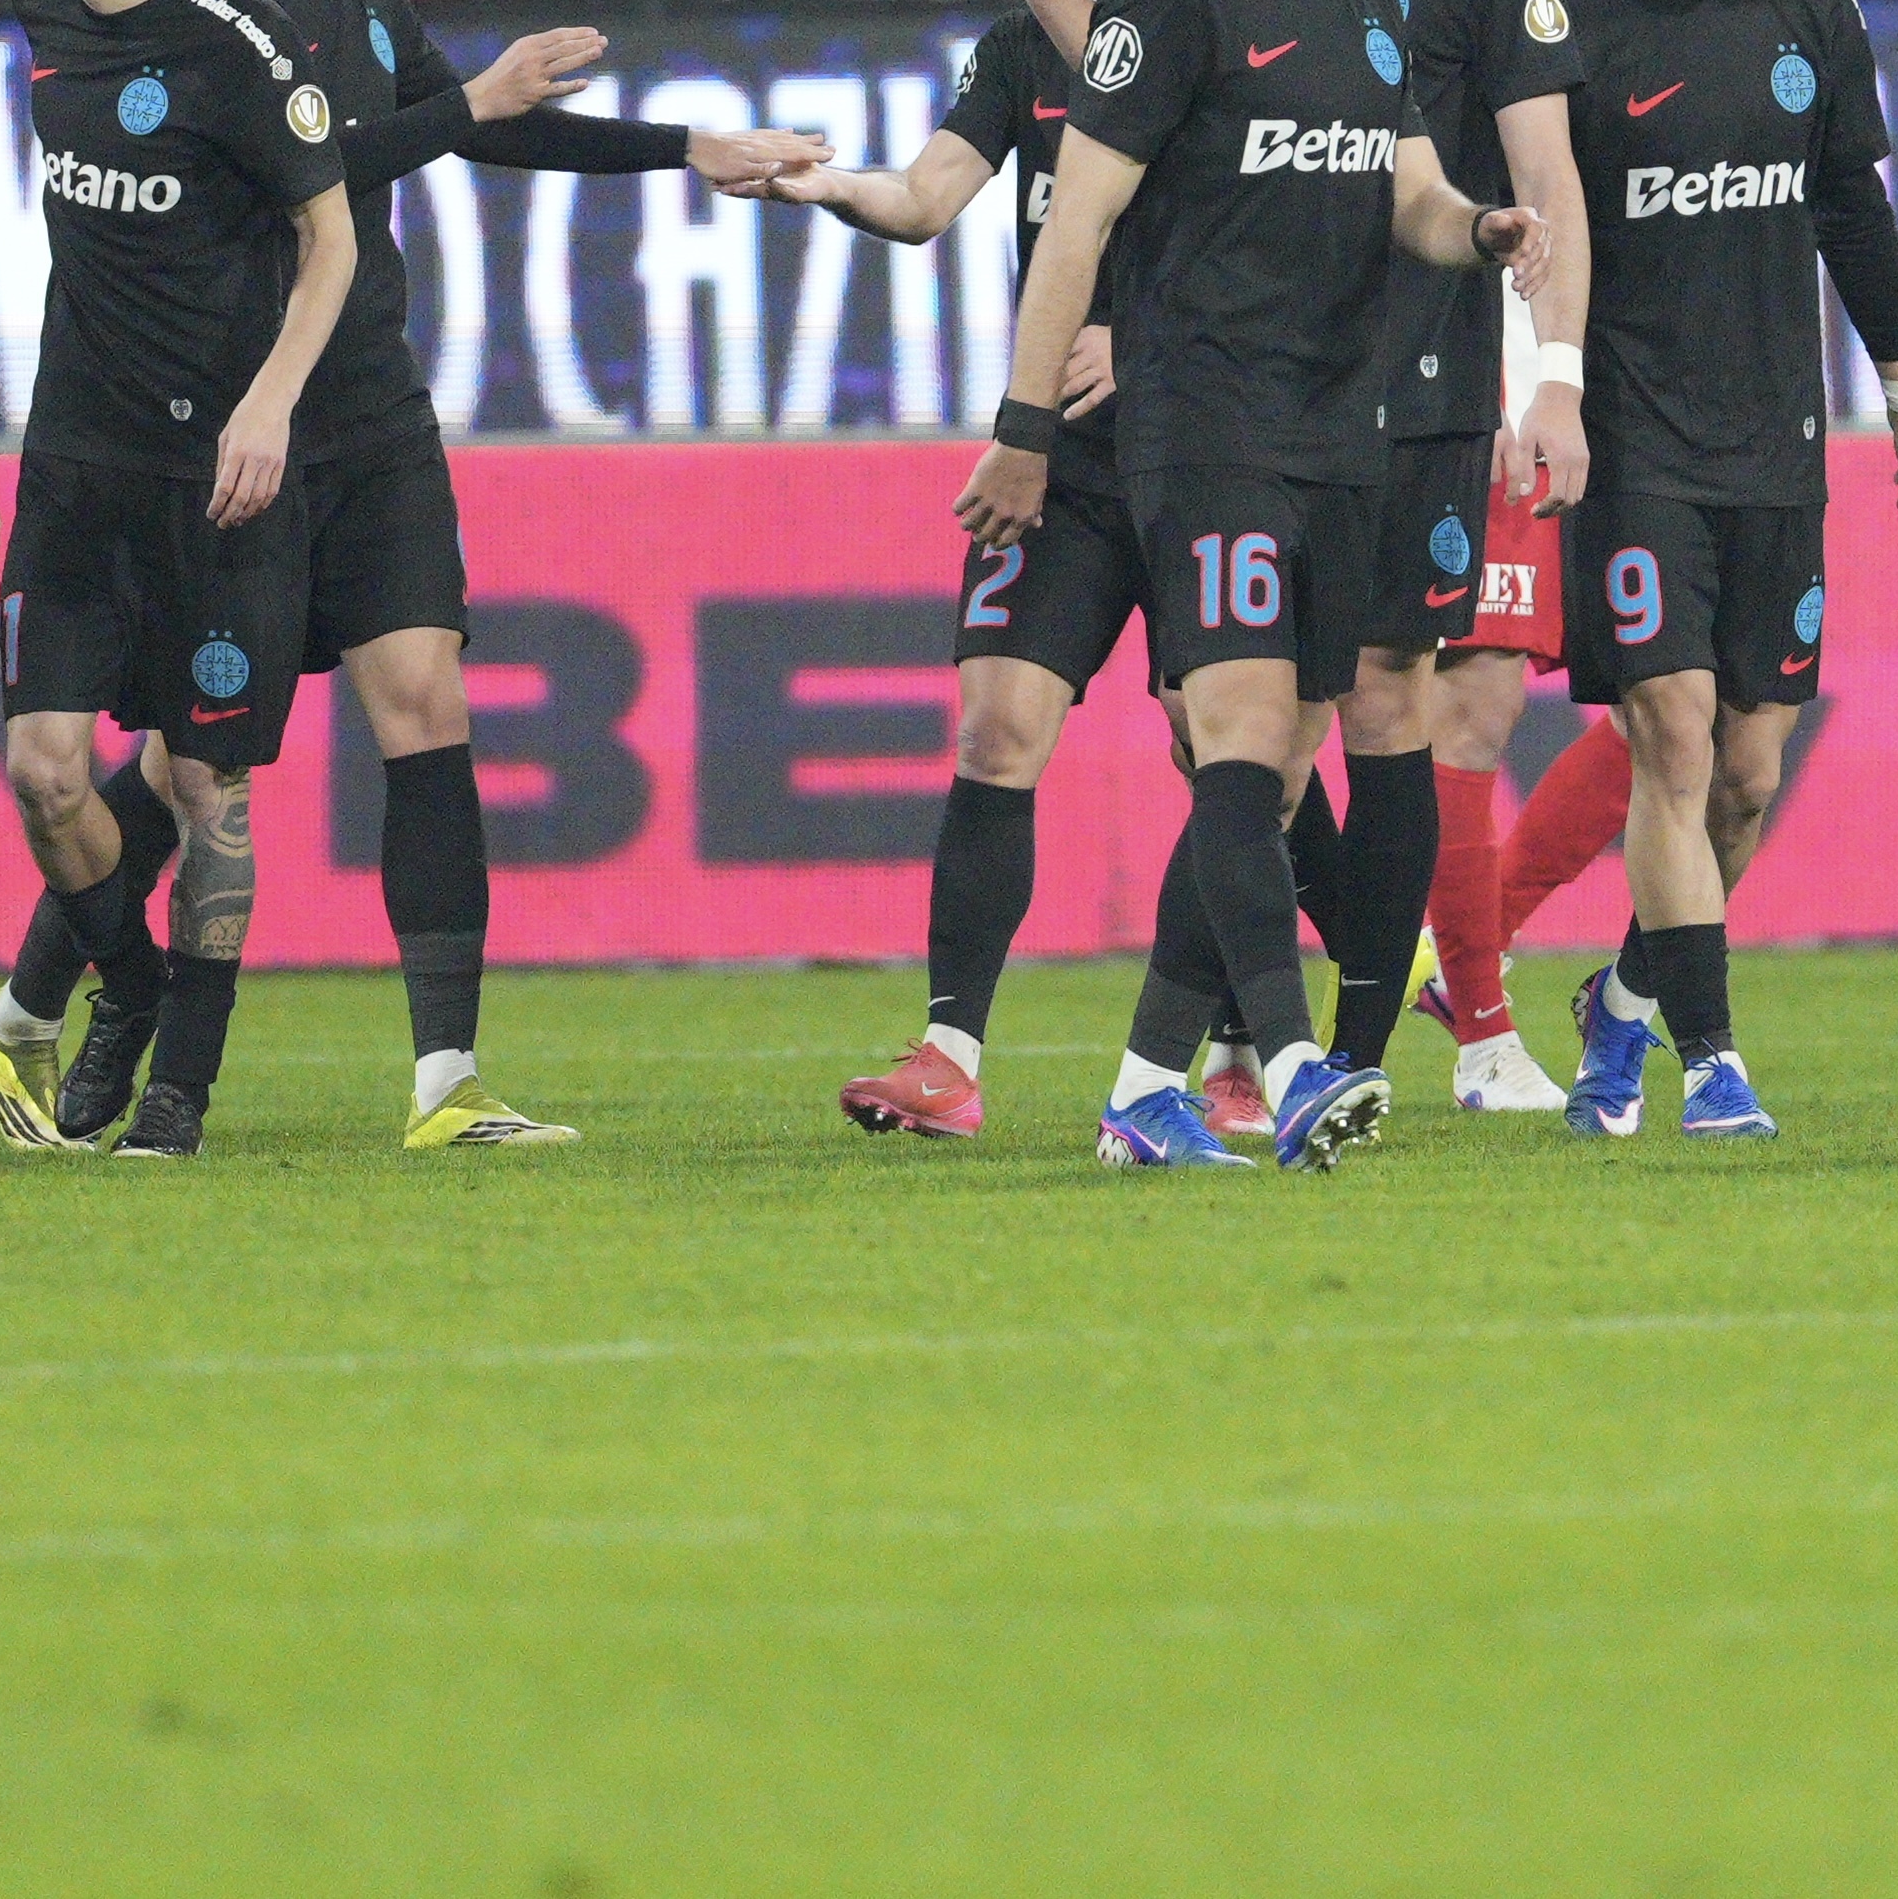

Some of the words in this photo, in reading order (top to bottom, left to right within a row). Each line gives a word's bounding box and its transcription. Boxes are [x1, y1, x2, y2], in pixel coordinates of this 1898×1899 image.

[235, 14, 277, 59] tosto
[1088, 23, 1138, 84] MG
[45, 151, 182, 213] etano
[1191, 531, 1282, 629] 16
[1478, 562, 1537, 604] EY
[1606, 546, 1663, 645] 9
